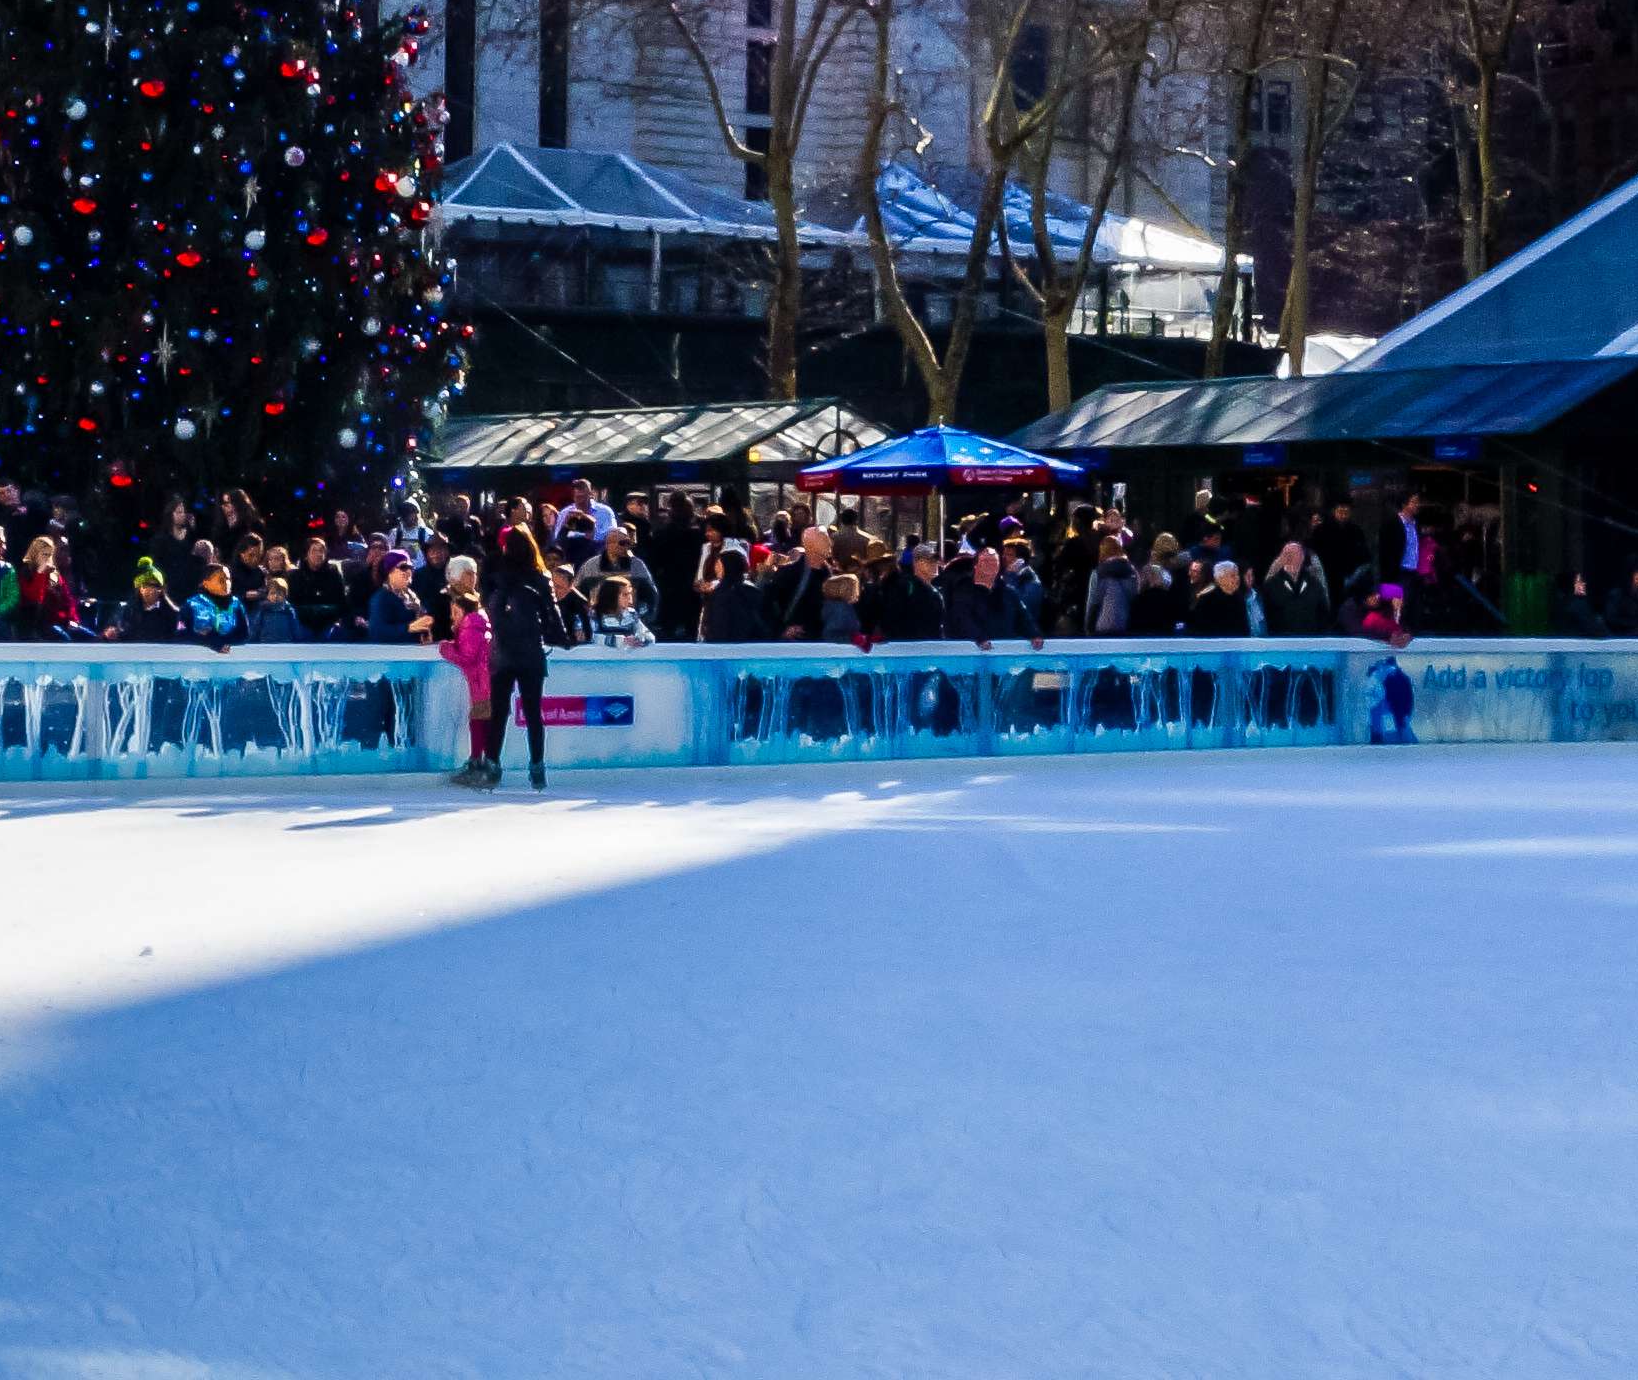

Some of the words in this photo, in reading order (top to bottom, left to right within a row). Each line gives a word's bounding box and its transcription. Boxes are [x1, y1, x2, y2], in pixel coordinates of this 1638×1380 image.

[1423, 664, 1466, 689] Add
[1472, 671, 1487, 689] a
[1570, 699, 1596, 721] to
